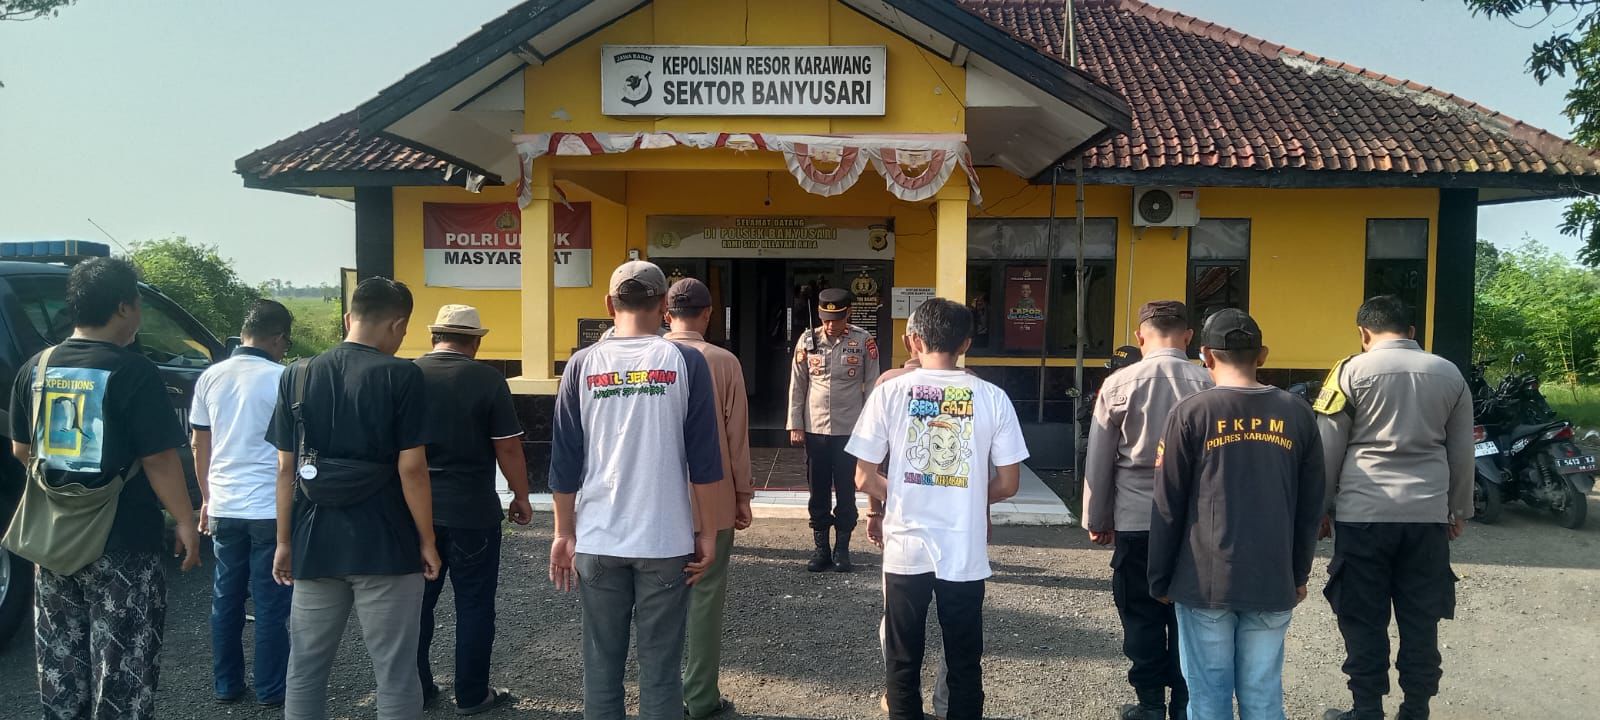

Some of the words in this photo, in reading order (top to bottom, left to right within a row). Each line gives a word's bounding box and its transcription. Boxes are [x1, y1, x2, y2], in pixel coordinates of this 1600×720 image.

[662, 56, 742, 75] KEPOLISIAN
[746, 56, 791, 75] RESOR
[794, 55, 872, 75] KARAWANG
[663, 80, 746, 105] SEKTOR
[751, 80, 871, 105] BANYUSARI
[736, 218, 772, 227] SELAMAT
[774, 218, 805, 227] DATANG
[445, 233, 499, 246] POLRI
[703, 228, 716, 240] DI
[720, 228, 766, 240] POLSEK
[768, 228, 838, 240] BANYUSARI
[721, 240, 741, 249] KAMI
[742, 240, 761, 249] SIAP
[444, 251, 572, 265] MASYARAT
[45, 378, 95, 391] XPEDITIONS
[911, 385, 943, 401] BEDA
[909, 399, 940, 416] BEDA
[1206, 433, 1241, 451] POLRES
[1243, 432, 1293, 450] KARAWANG
